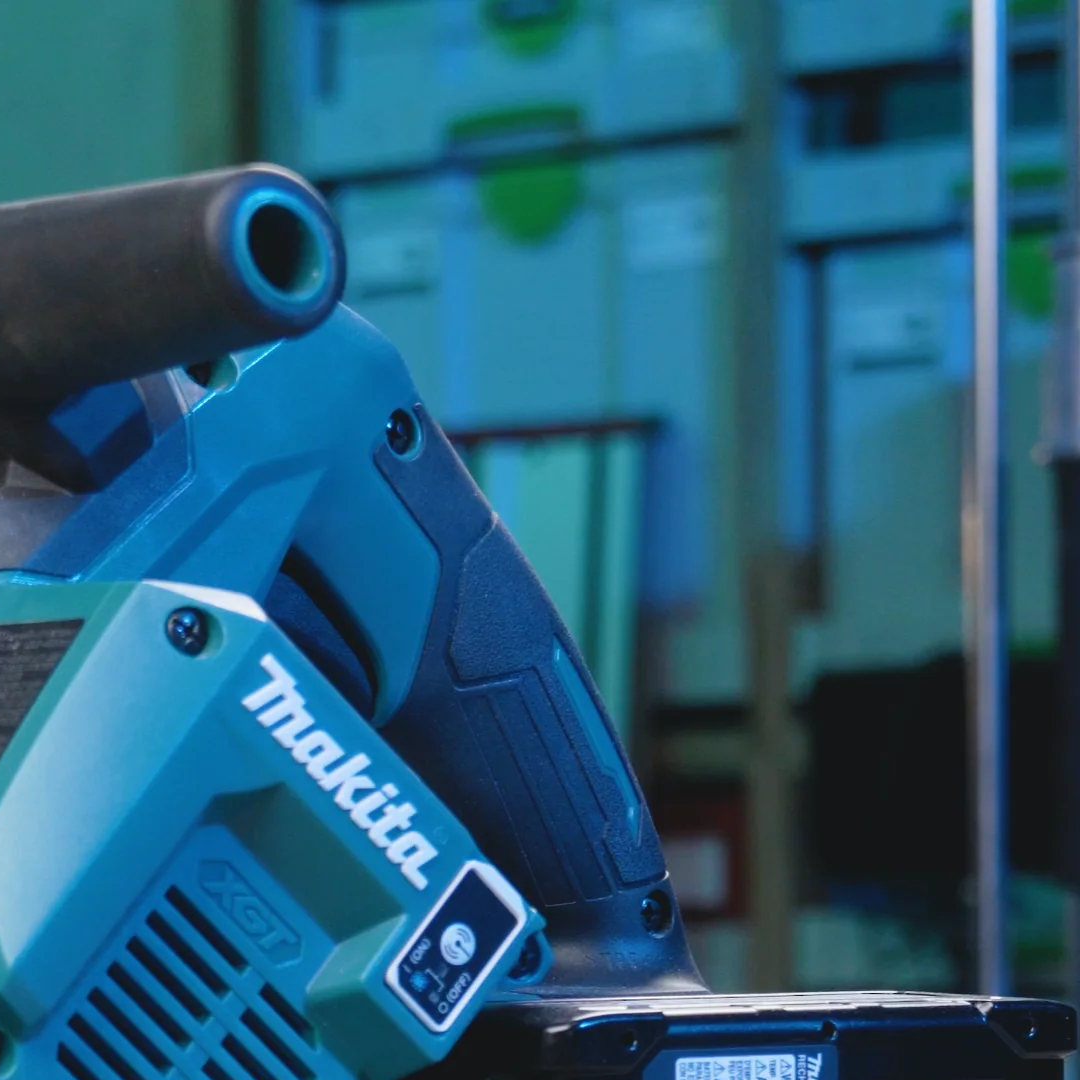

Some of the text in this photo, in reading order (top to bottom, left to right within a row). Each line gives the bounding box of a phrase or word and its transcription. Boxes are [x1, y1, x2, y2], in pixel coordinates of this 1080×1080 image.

[241, 653, 439, 891] Makita
[203, 867, 301, 947] XGT
[446, 972, 472, 1003] (OFF)
